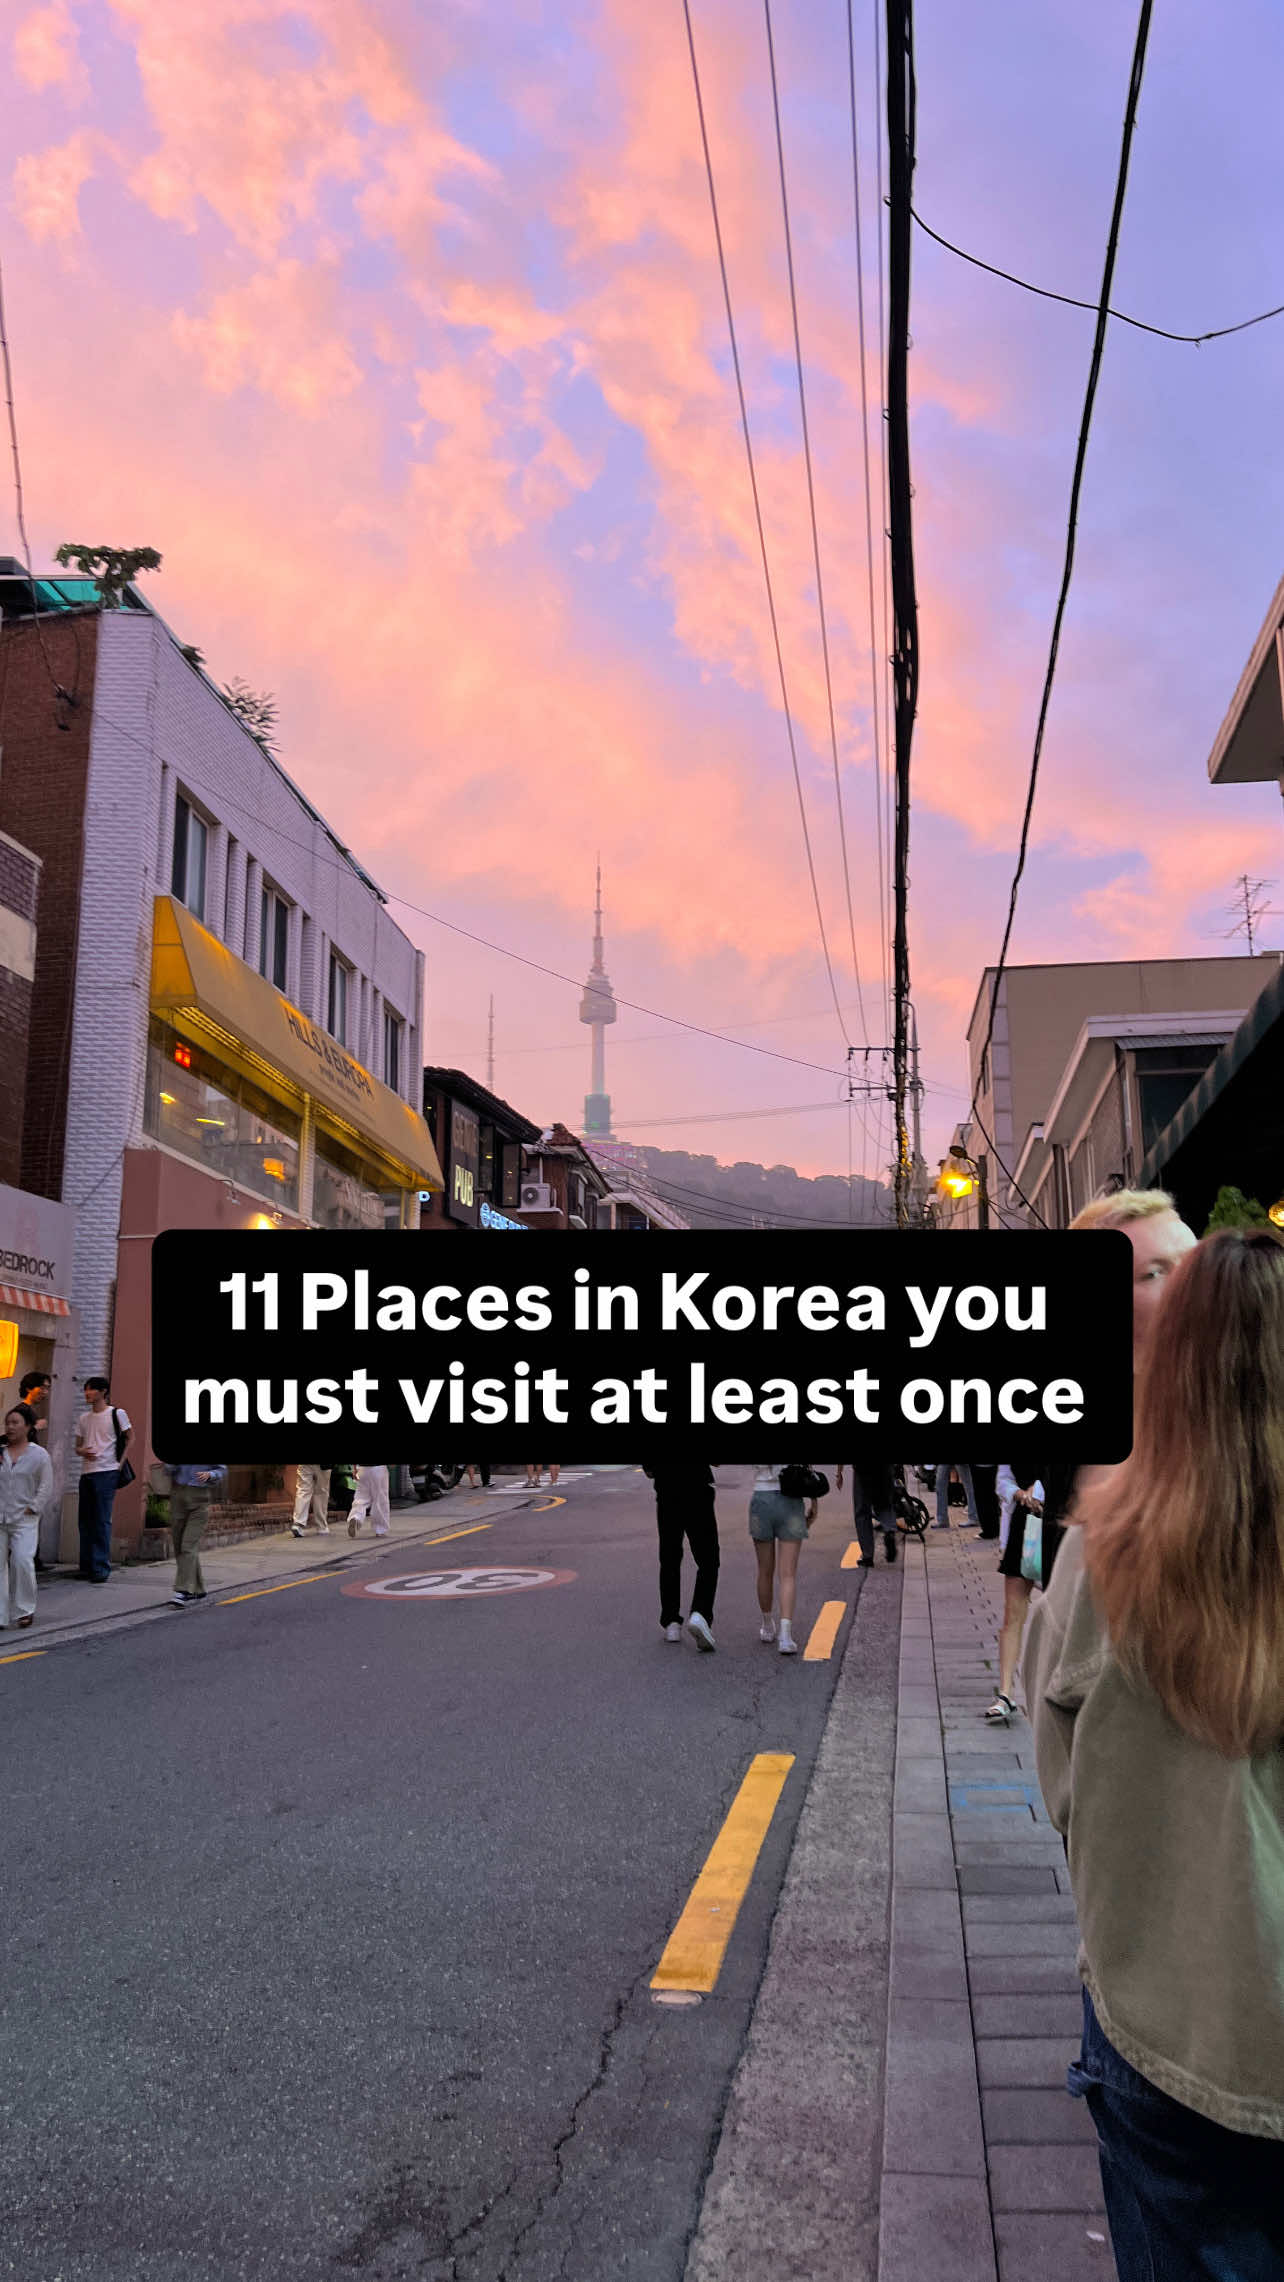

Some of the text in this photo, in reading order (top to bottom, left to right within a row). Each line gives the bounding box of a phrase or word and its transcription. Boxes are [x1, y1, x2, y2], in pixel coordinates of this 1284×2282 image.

[284, 1007, 323, 1057] HILLS
[455, 1164, 474, 1207] PUB
[384, 1572, 540, 1592] 30
